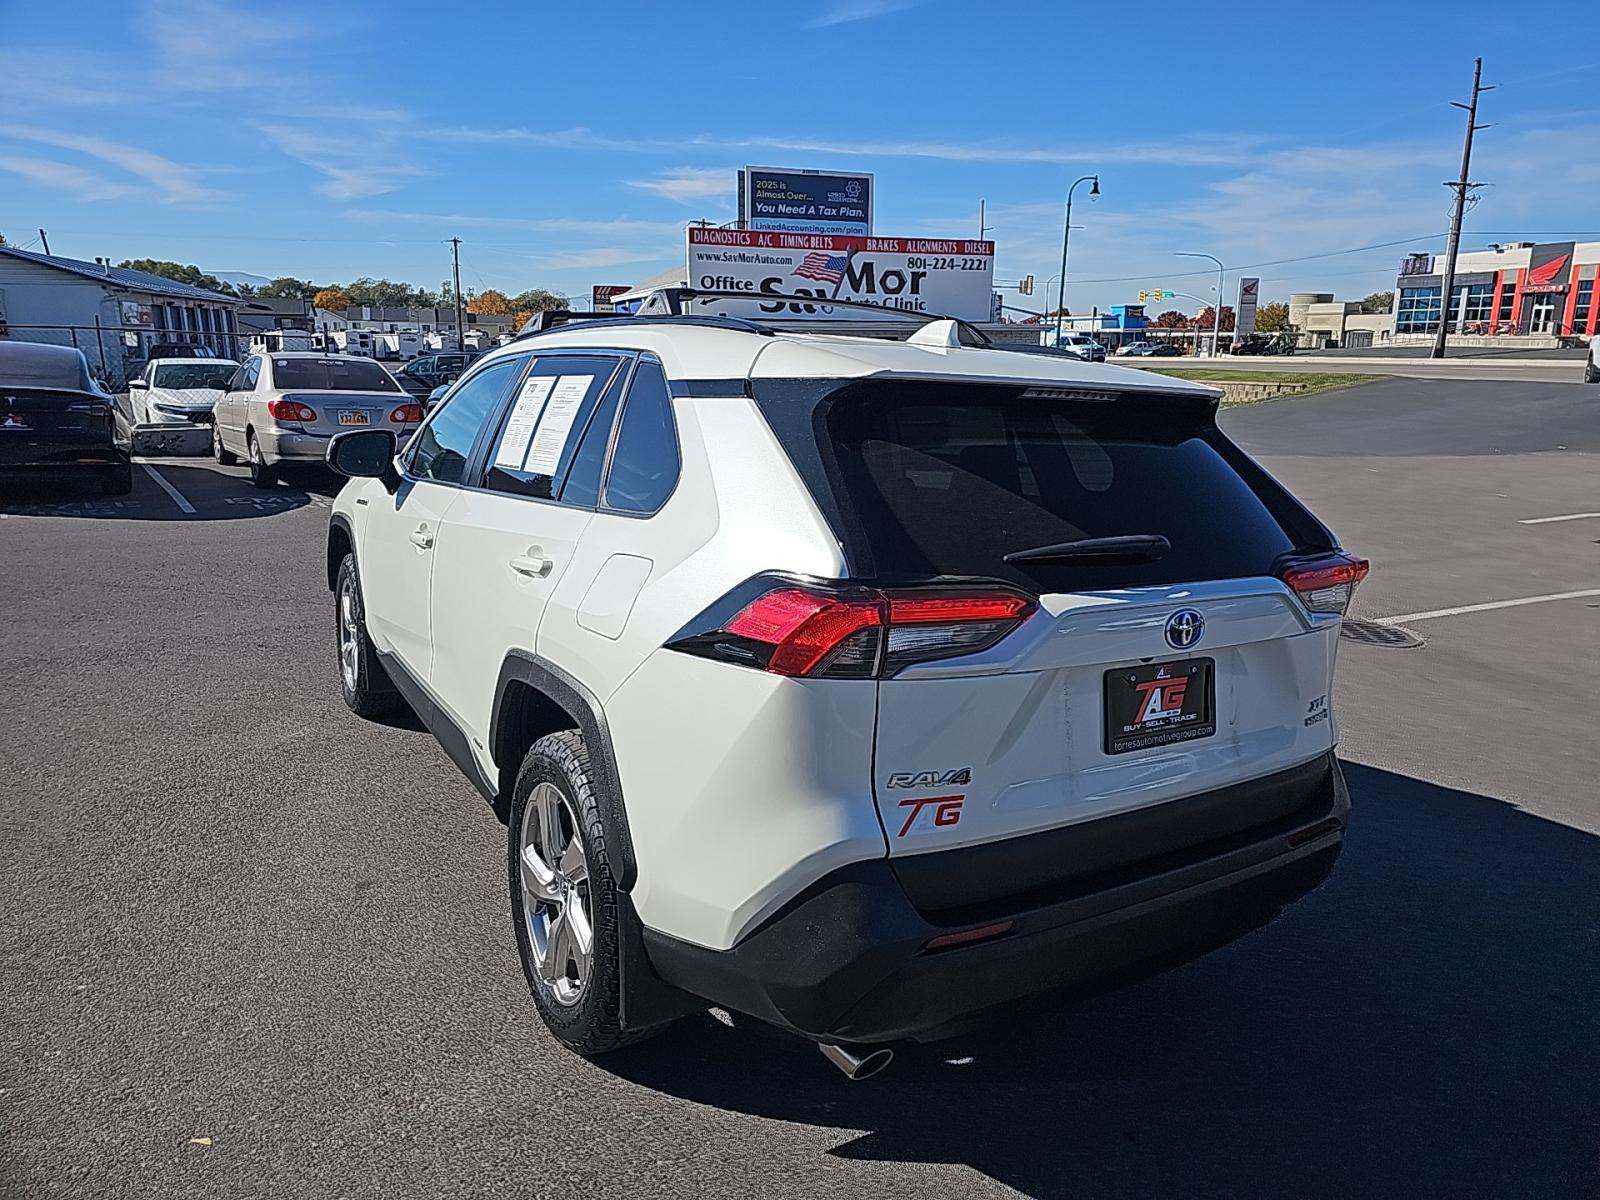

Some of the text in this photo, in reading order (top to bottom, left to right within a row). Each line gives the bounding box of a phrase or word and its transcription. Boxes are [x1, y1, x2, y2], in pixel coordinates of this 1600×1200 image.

[755, 180, 786, 190] 2025 is
[756, 191, 785, 199] Almost
[755, 202, 865, 218] You Need A Tax Plan.
[755, 222, 863, 236] LinkedAccounting.com/plan
[693, 231, 991, 255] DIAGNOSTICS A/C TIMING BELTS BRAKES ALIGNMENTS DIESEL
[696, 251, 793, 266] www.SavMorAuto.com
[906, 256, 987, 271] 801-224-2221
[700, 274, 754, 291] Office
[882, 296, 927, 311] Clinic
[1134, 676, 1188, 723] TAG
[1123, 723, 1142, 732] BUY
[1145, 719, 1166, 728] SELL
[1170, 713, 1197, 724] TRADE
[1114, 726, 1213, 751] torresautomotivegroup.com
[886, 767, 972, 789] RAV4
